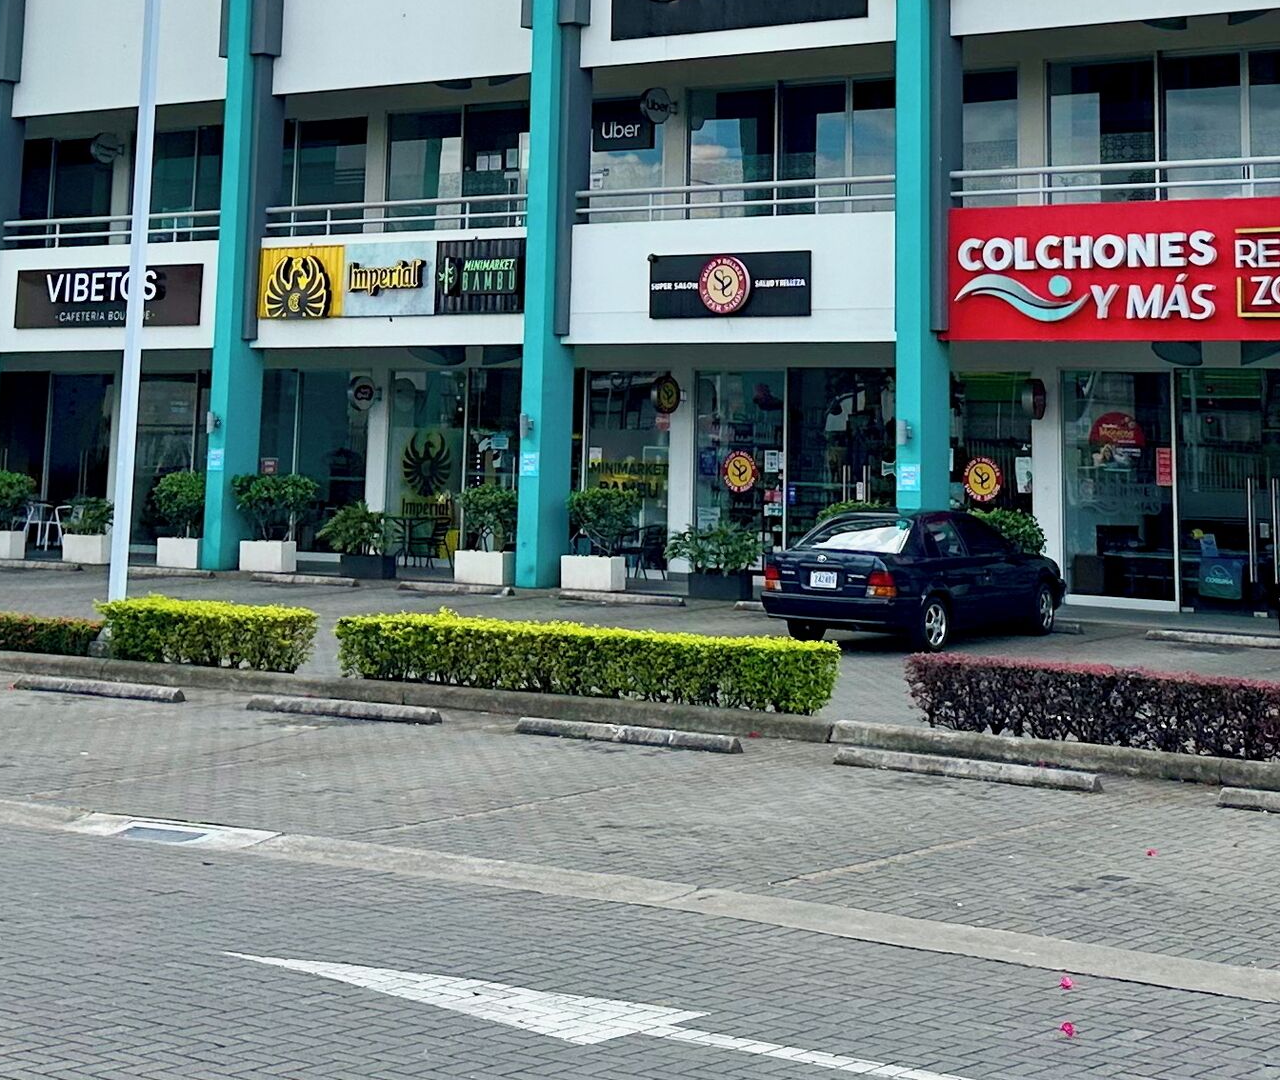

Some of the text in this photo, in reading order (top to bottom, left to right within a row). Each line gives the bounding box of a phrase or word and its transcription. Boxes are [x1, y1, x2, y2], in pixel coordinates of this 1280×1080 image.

[646, 98, 669, 112] Uber
[601, 121, 640, 139] Uber
[957, 230, 1218, 272] COLCHONES
[463, 259, 516, 271] MINIMARKET
[46, 270, 157, 303] VIBETOS
[349, 260, 422, 295] Imperial
[462, 270, 516, 291] BAMBU
[651, 282, 672, 291] SUPER
[1090, 273, 1217, 321] Y MÁS
[59, 311, 105, 322] CAFETERIA
[588, 461, 669, 476] MINIMARKET
[402, 497, 452, 517] Imperial
